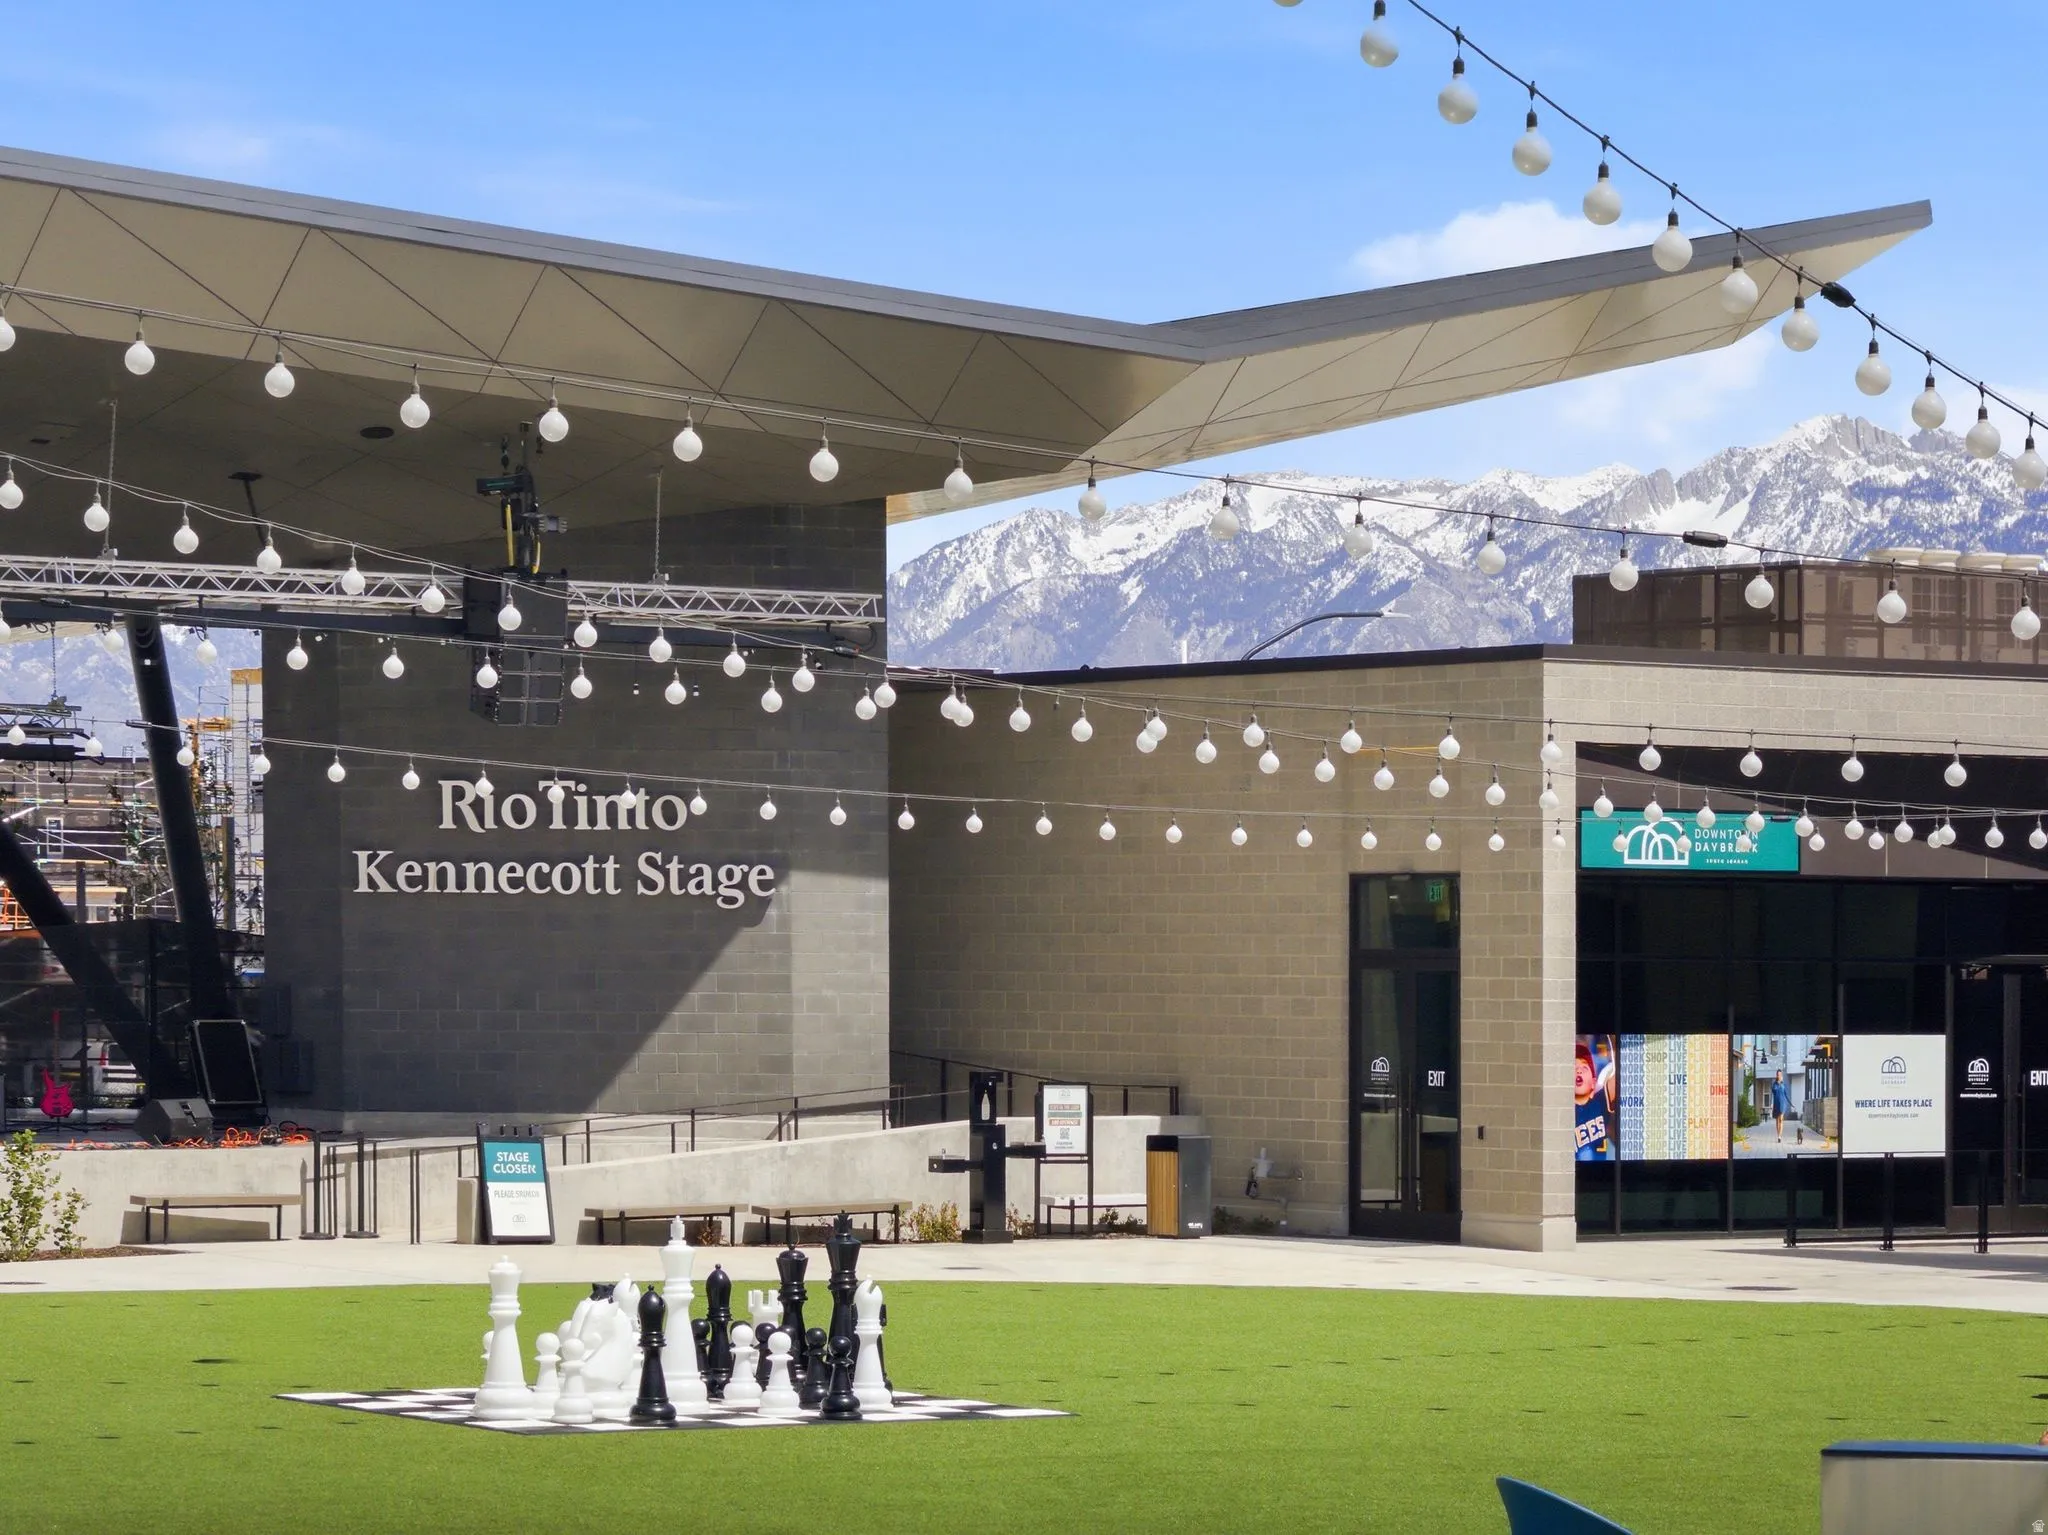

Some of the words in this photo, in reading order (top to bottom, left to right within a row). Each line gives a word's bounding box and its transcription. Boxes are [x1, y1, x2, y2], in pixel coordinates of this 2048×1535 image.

[1694, 841, 1759, 853] DAYBRK
[352, 850, 622, 894] Kennecott
[636, 851, 776, 910] Stage
[1645, 1052, 1667, 1062] SHOP
[1428, 1070, 1446, 1087] EXIT
[1668, 1074, 1687, 1084] LIVE
[2030, 1070, 2048, 1086] ENT
[1710, 1085, 1728, 1095] DINE
[1620, 1096, 1644, 1106] WORK
[1854, 1099, 1876, 1108] WHERE
[1877, 1099, 1891, 1108] LIFE
[1892, 1099, 1912, 1108] TAKES
[1913, 1099, 1933, 1108] PLACE
[1688, 1118, 1709, 1128] PLAY
[1575, 1115, 1605, 1152] EES
[496, 1151, 530, 1162] STAGE
